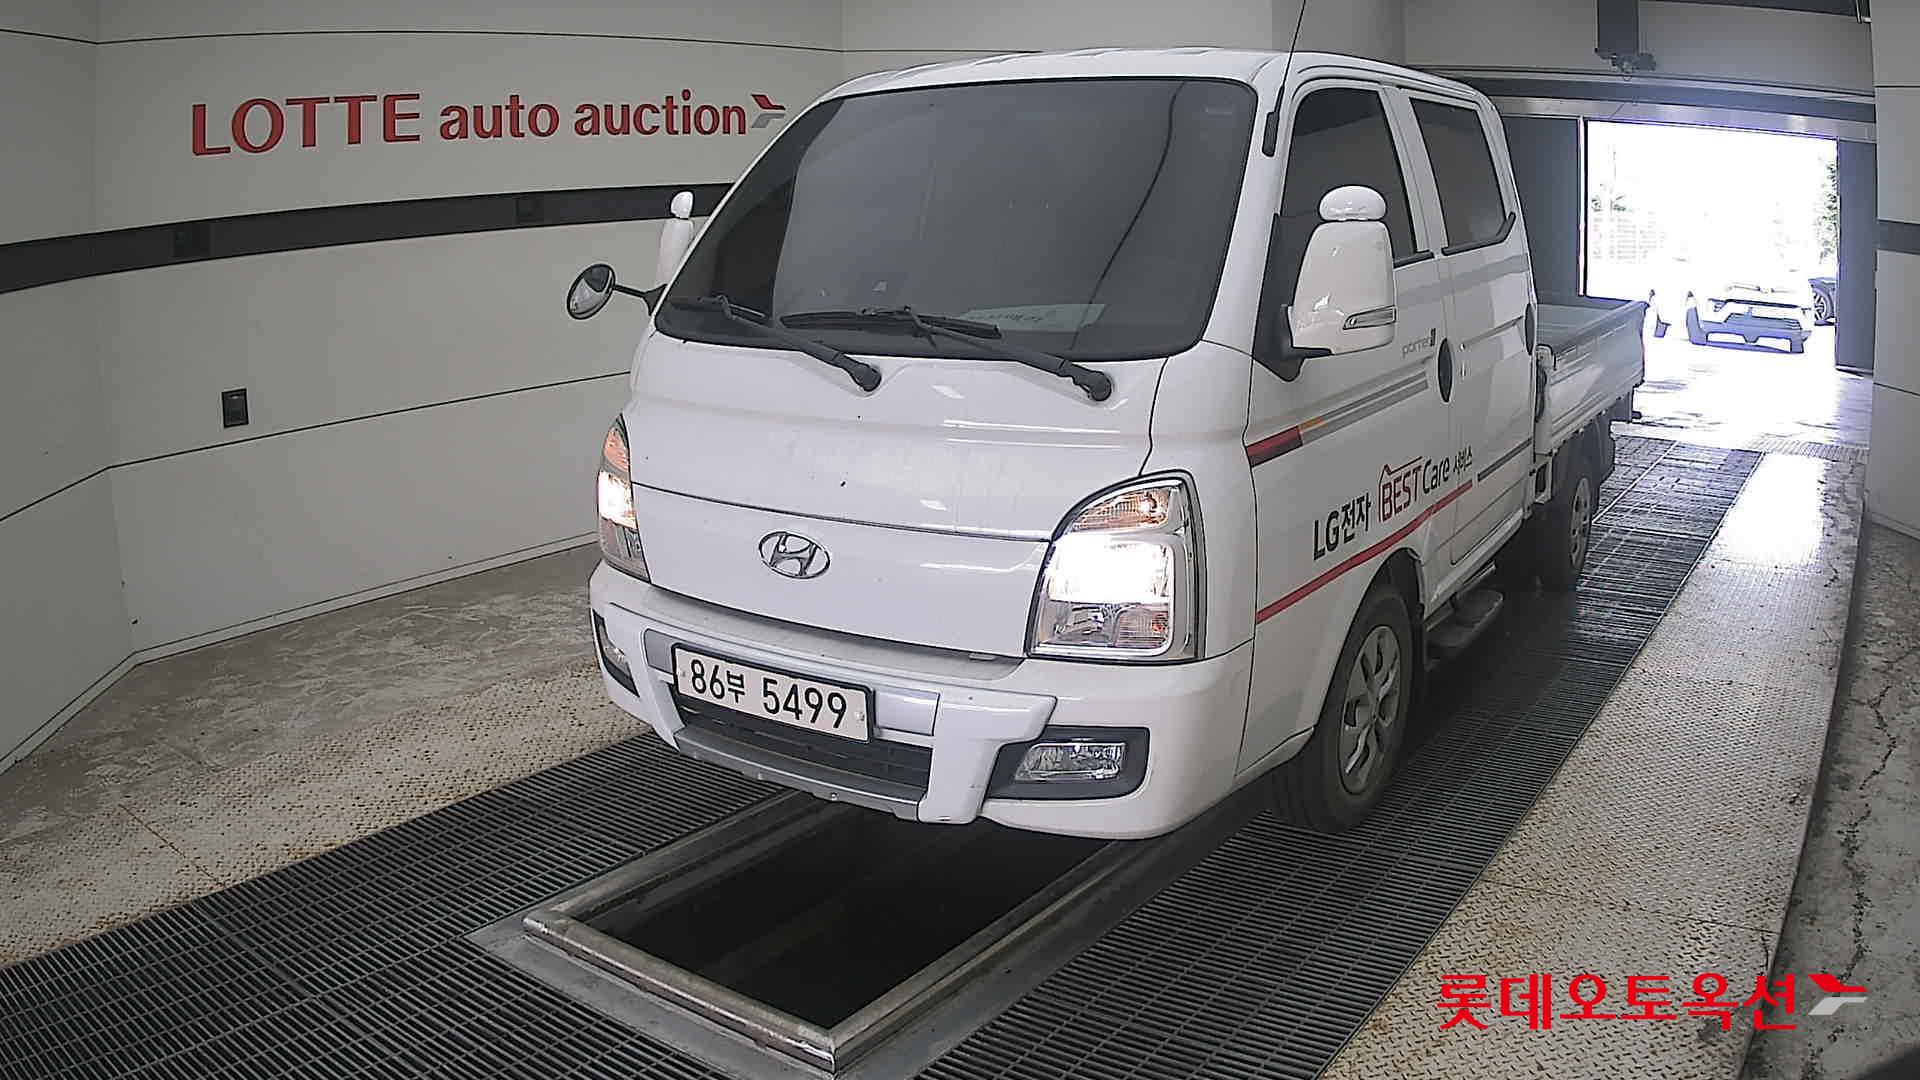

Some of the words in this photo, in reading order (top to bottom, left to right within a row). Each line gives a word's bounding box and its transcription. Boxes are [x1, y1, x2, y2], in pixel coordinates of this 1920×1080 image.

[192, 93, 420, 156] LOTTE
[439, 94, 560, 140] auto
[574, 89, 747, 136] auction
[1313, 492, 1372, 561] LG전자
[690, 659, 745, 704] 86부
[762, 677, 847, 729] 5499
